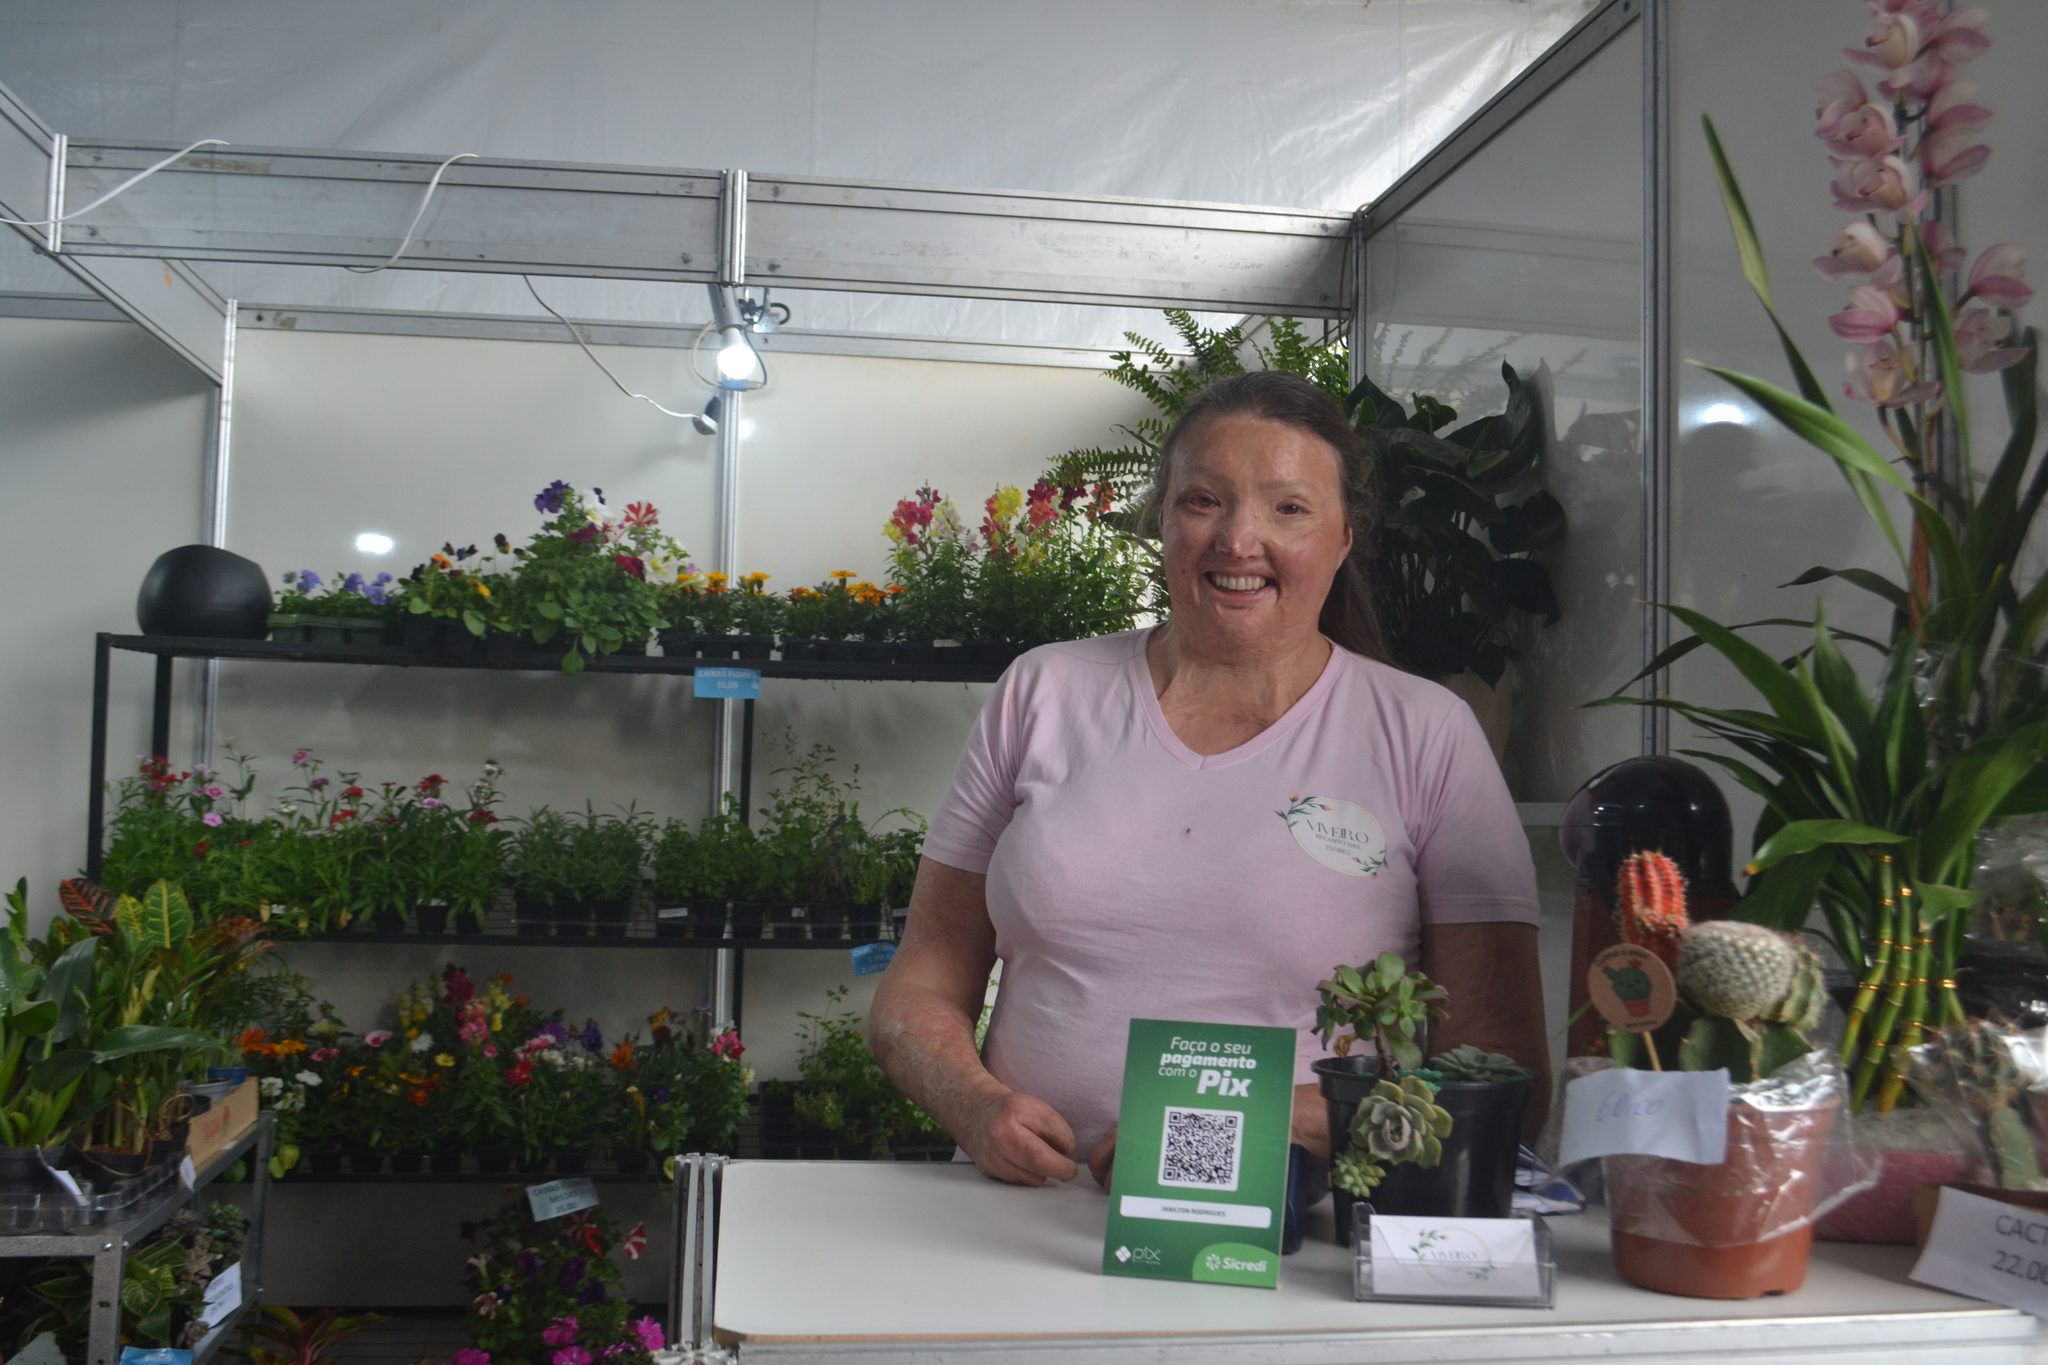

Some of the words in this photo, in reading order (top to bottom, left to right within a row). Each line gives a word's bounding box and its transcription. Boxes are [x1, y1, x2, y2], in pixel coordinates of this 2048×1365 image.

[1306, 818, 1369, 844] VIVEIRO
[1170, 1036, 1207, 1054] Faça
[1210, 1042, 1220, 1053] o
[1223, 1043, 1252, 1055] seu
[1159, 1053, 1257, 1069] pagamento
[1158, 1066, 1186, 1078] com
[1189, 1068, 1197, 1078] o
[1197, 1069, 1253, 1098] Pix
[1133, 1245, 1161, 1263] pix
[1222, 1255, 1268, 1273] Sicredi
